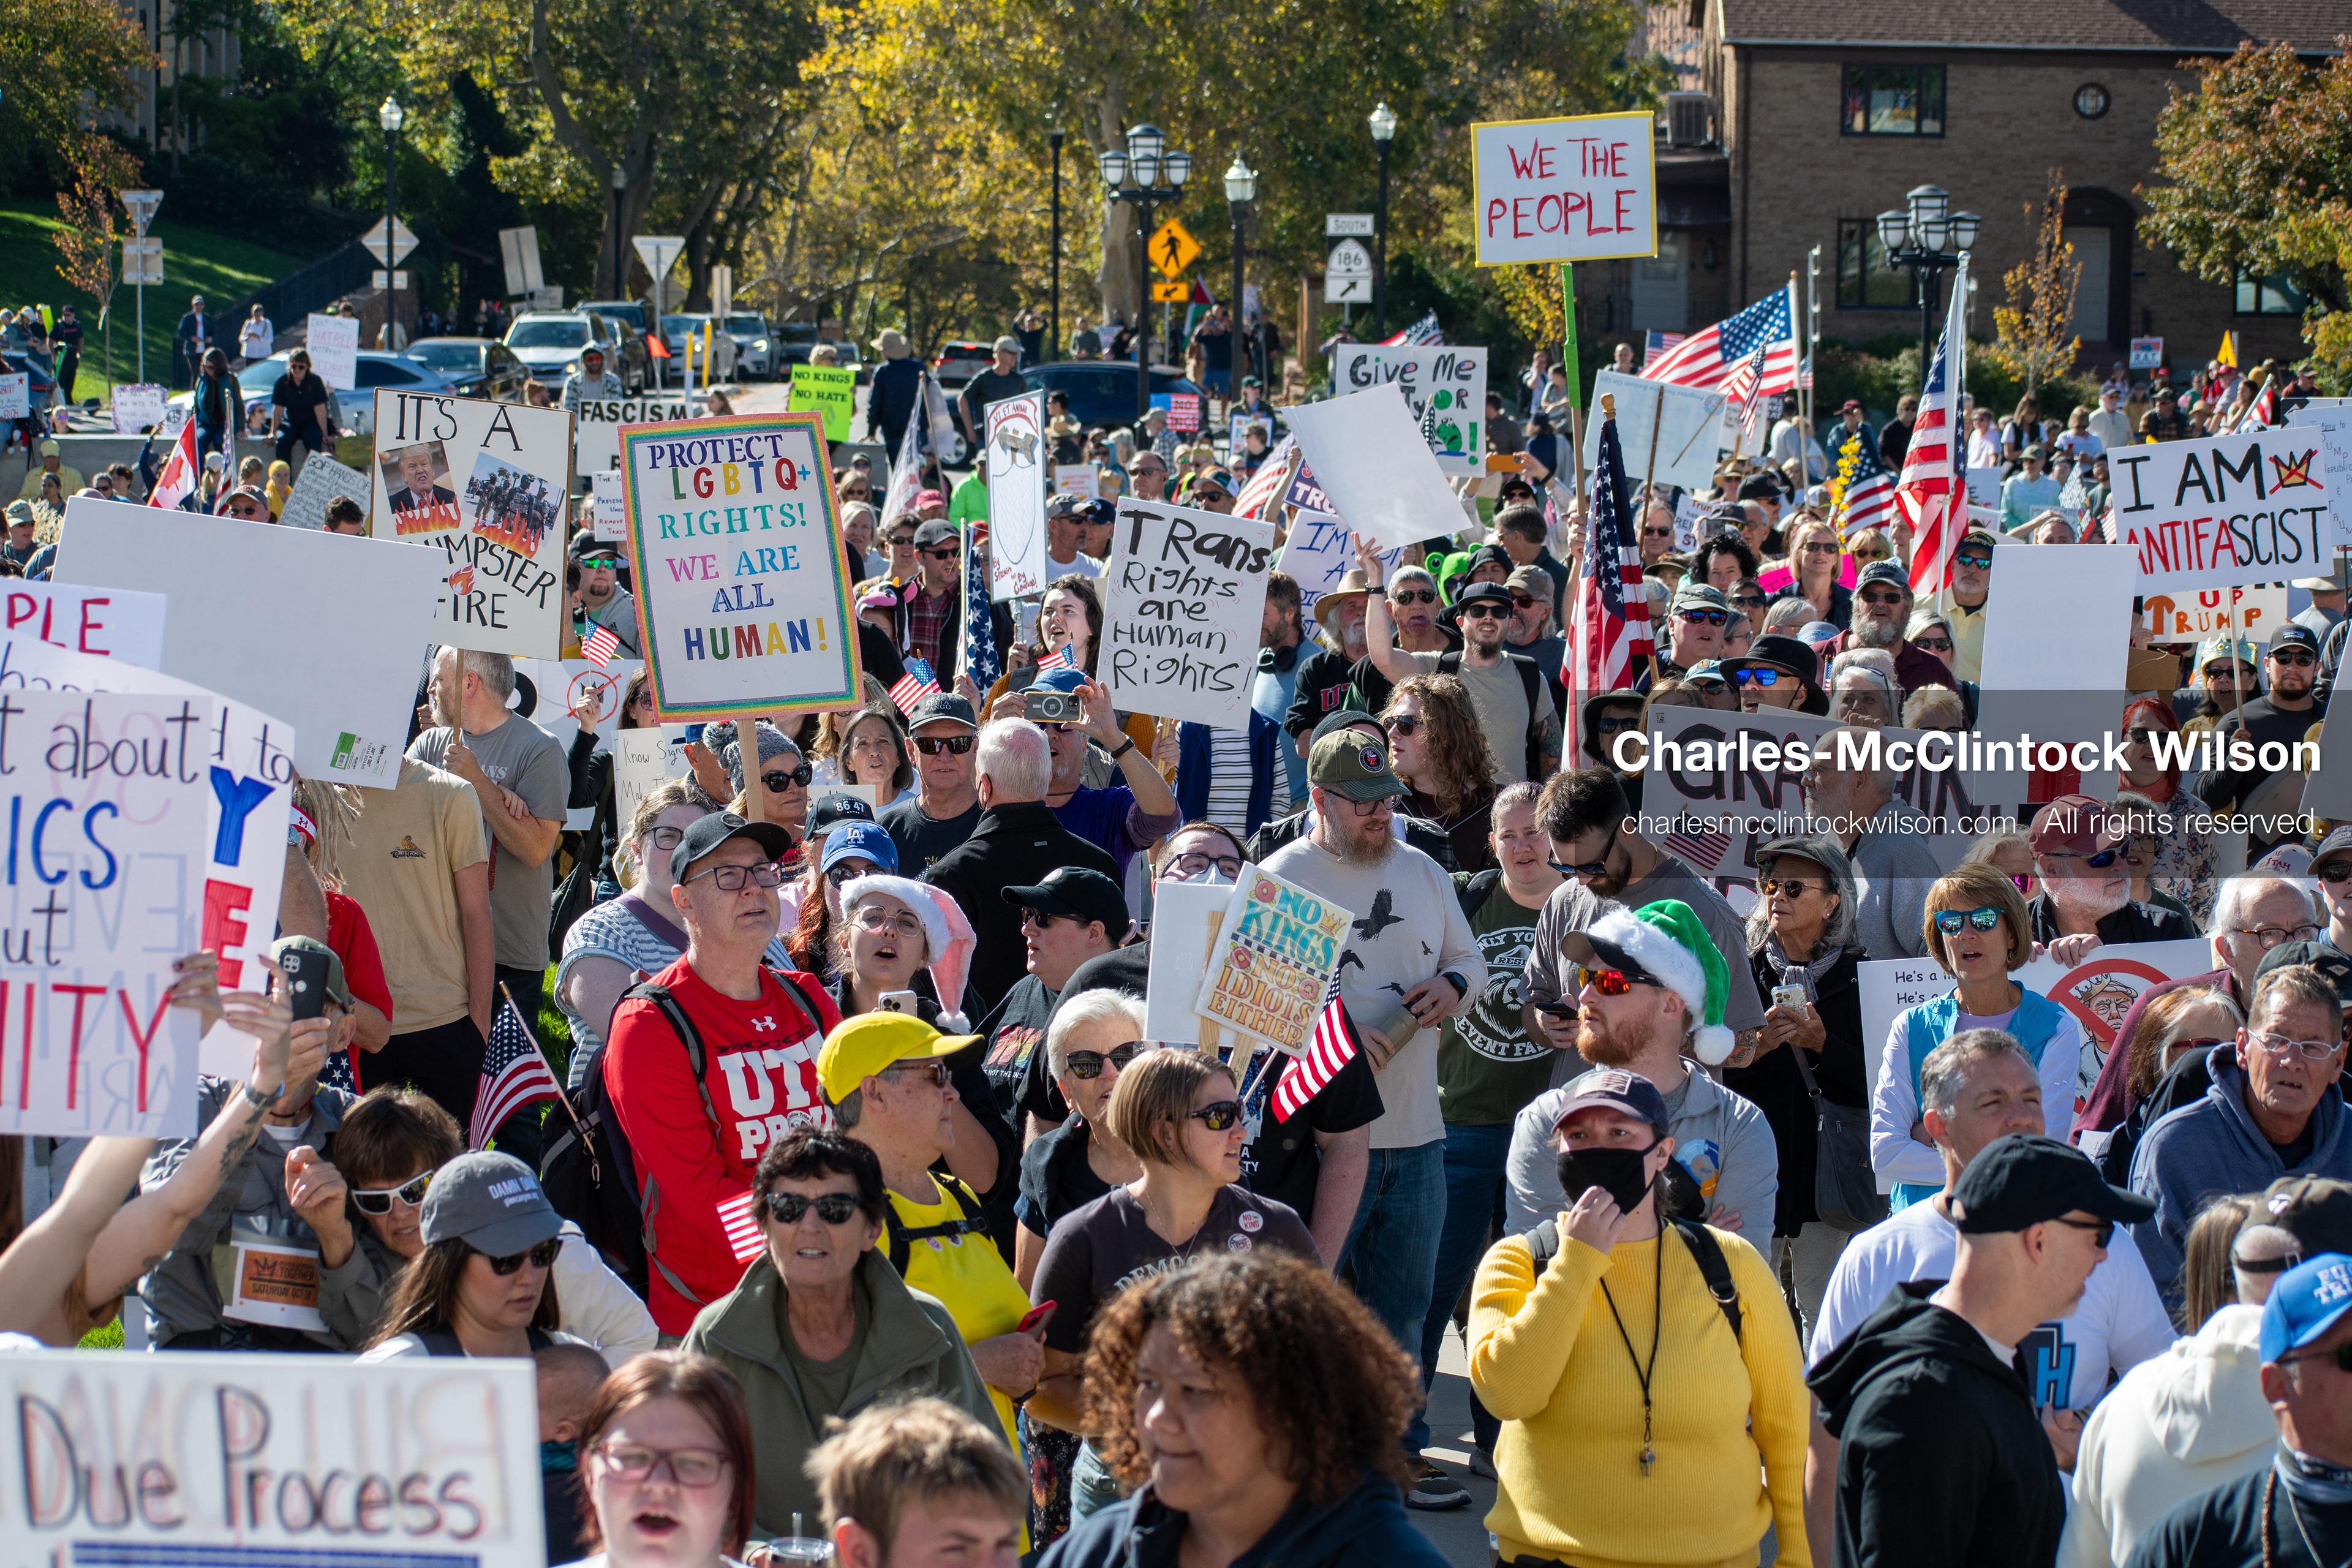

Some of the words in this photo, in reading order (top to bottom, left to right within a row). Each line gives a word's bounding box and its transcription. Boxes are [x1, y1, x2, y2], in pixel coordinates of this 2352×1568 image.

[1507, 137, 1558, 179] WE
[1566, 137, 1629, 178] THE
[1333, 219, 1367, 232] SOUTH
[1488, 189, 1637, 239] PEOPLE
[1338, 252, 1362, 266] 186
[794, 372, 810, 380] NO
[813, 372, 850, 384] KINGS
[1349, 354, 1419, 387] Give
[1432, 353, 1476, 382] Me
[581, 401, 688, 423] FASCISM
[796, 390, 812, 399] NO
[816, 391, 848, 402] HATE
[396, 394, 458, 441] IT'S
[480, 405, 522, 451] A
[2339, 420, 2345, 429] to
[648, 434, 783, 470] PROTECT
[307, 456, 331, 471] GOP
[330, 465, 357, 488] HANDS
[672, 458, 812, 500] LGBTQ+
[2117, 456, 2154, 513] I
[2174, 443, 2267, 507] AM
[658, 502, 807, 539] RIGHTS!
[1296, 522, 1348, 555] I'M
[2126, 506, 2328, 575] ANTIFASCIST
[666, 554, 720, 582] WE
[735, 545, 800, 576] ARE
[1123, 562, 1240, 598] Rights
[1323, 561, 1348, 582] A
[712, 582, 774, 612] ALL
[2143, 595, 2261, 636] TRUMP
[1113, 621, 1226, 654] Human
[1113, 649, 1253, 700] Rights!
[45, 698, 200, 785] about
[253, 723, 293, 785] to
[624, 737, 650, 766] Know
[657, 740, 685, 766] Signs
[835, 801, 851, 812] 86
[853, 801, 865, 813] 47
[846, 827, 865, 845] LA
[2259, 858, 2291, 871] UTAH
[1276, 886, 1322, 925] NO
[1237, 900, 1338, 971] KINGS
[1477, 933, 1507, 952] NLY
[1512, 932, 1535, 943] YO
[1251, 954, 1297, 989] NO
[1895, 970, 1923, 983] He's
[1216, 965, 1316, 1030] IDIOTS
[1897, 991, 1925, 1005] He's
[1208, 992, 1303, 1050] EITHER
[488, 1178, 522, 1199] DAMN
[1244, 1221, 1260, 1229] KING
[280, 1266, 315, 1281] TOGETHER
[291, 1288, 304, 1298] OCT
[18, 1394, 185, 1530] Due
[216, 1384, 484, 1541] Process
